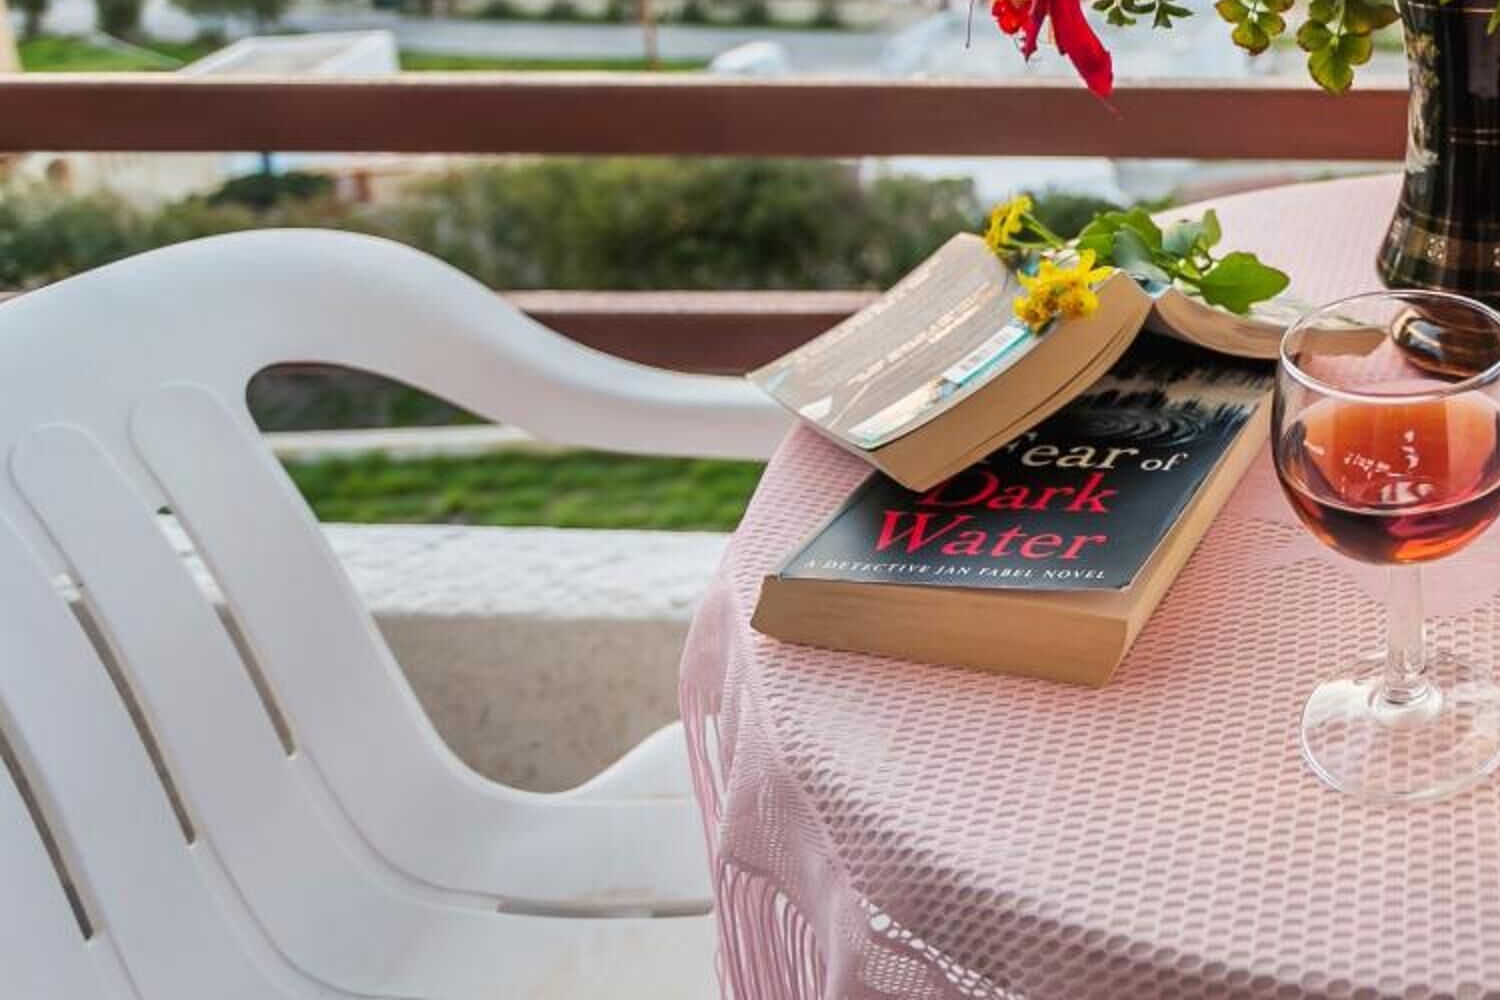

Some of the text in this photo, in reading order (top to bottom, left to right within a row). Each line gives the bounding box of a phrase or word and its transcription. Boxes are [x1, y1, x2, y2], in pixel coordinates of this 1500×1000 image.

[983, 431, 1188, 471] ear of
[914, 470, 1118, 513] Dark
[874, 509, 1108, 560] Water
[820, 560, 932, 575] DETECTIVE
[933, 564, 972, 576] JAN
[978, 566, 1033, 578] FABEL
[1042, 567, 1106, 580] NOVEL
